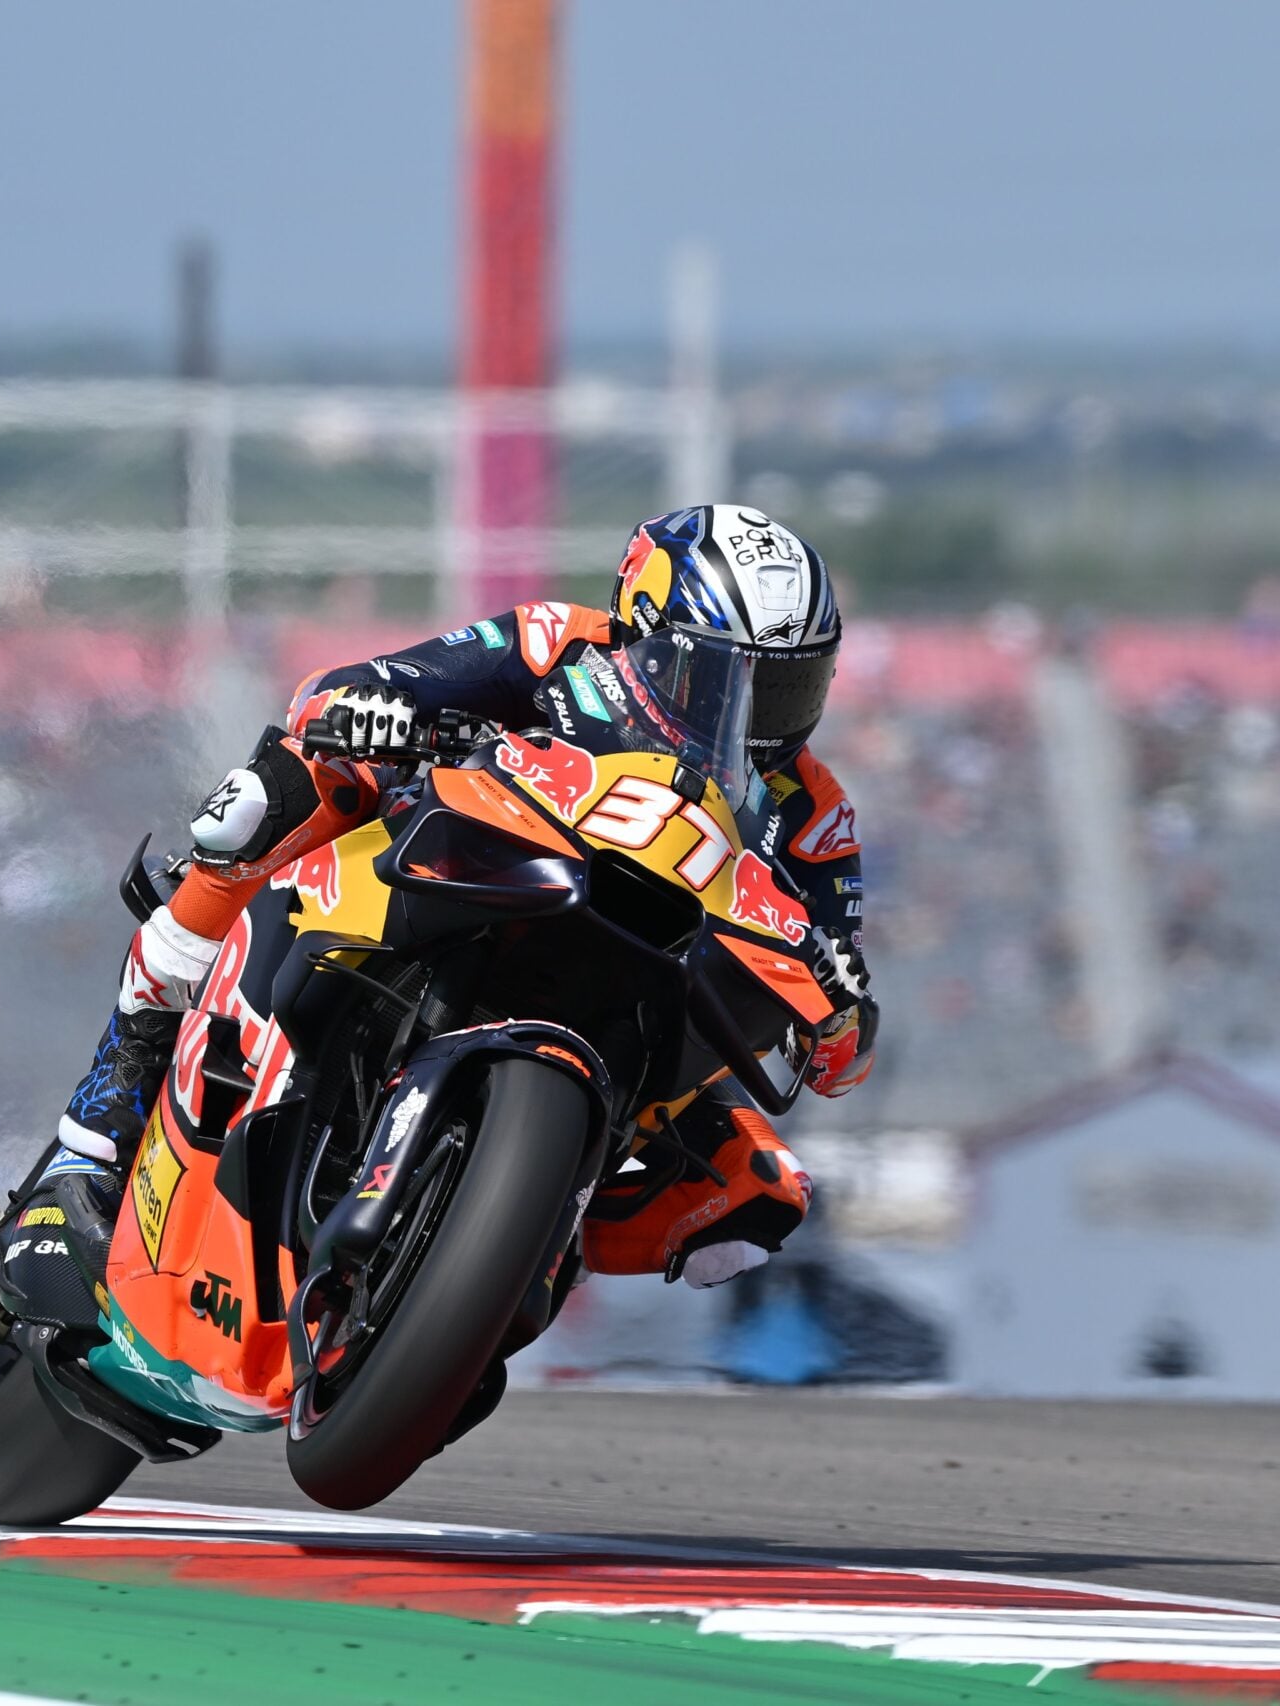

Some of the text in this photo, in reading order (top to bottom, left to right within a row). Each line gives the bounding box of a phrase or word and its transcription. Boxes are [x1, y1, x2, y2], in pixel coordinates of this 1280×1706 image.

[769, 652, 790, 660] YOU
[794, 651, 821, 659] WINGS
[597, 669, 627, 701] WRS
[553, 700, 576, 735] BAJAJ
[477, 775, 537, 829] READY TO RACE
[575, 774, 737, 893] 37
[535, 1045, 591, 1078] KTM
[144, 1219, 157, 1244] news
[190, 1270, 243, 1344] KTM
[112, 1319, 150, 1377] MOTOREX
